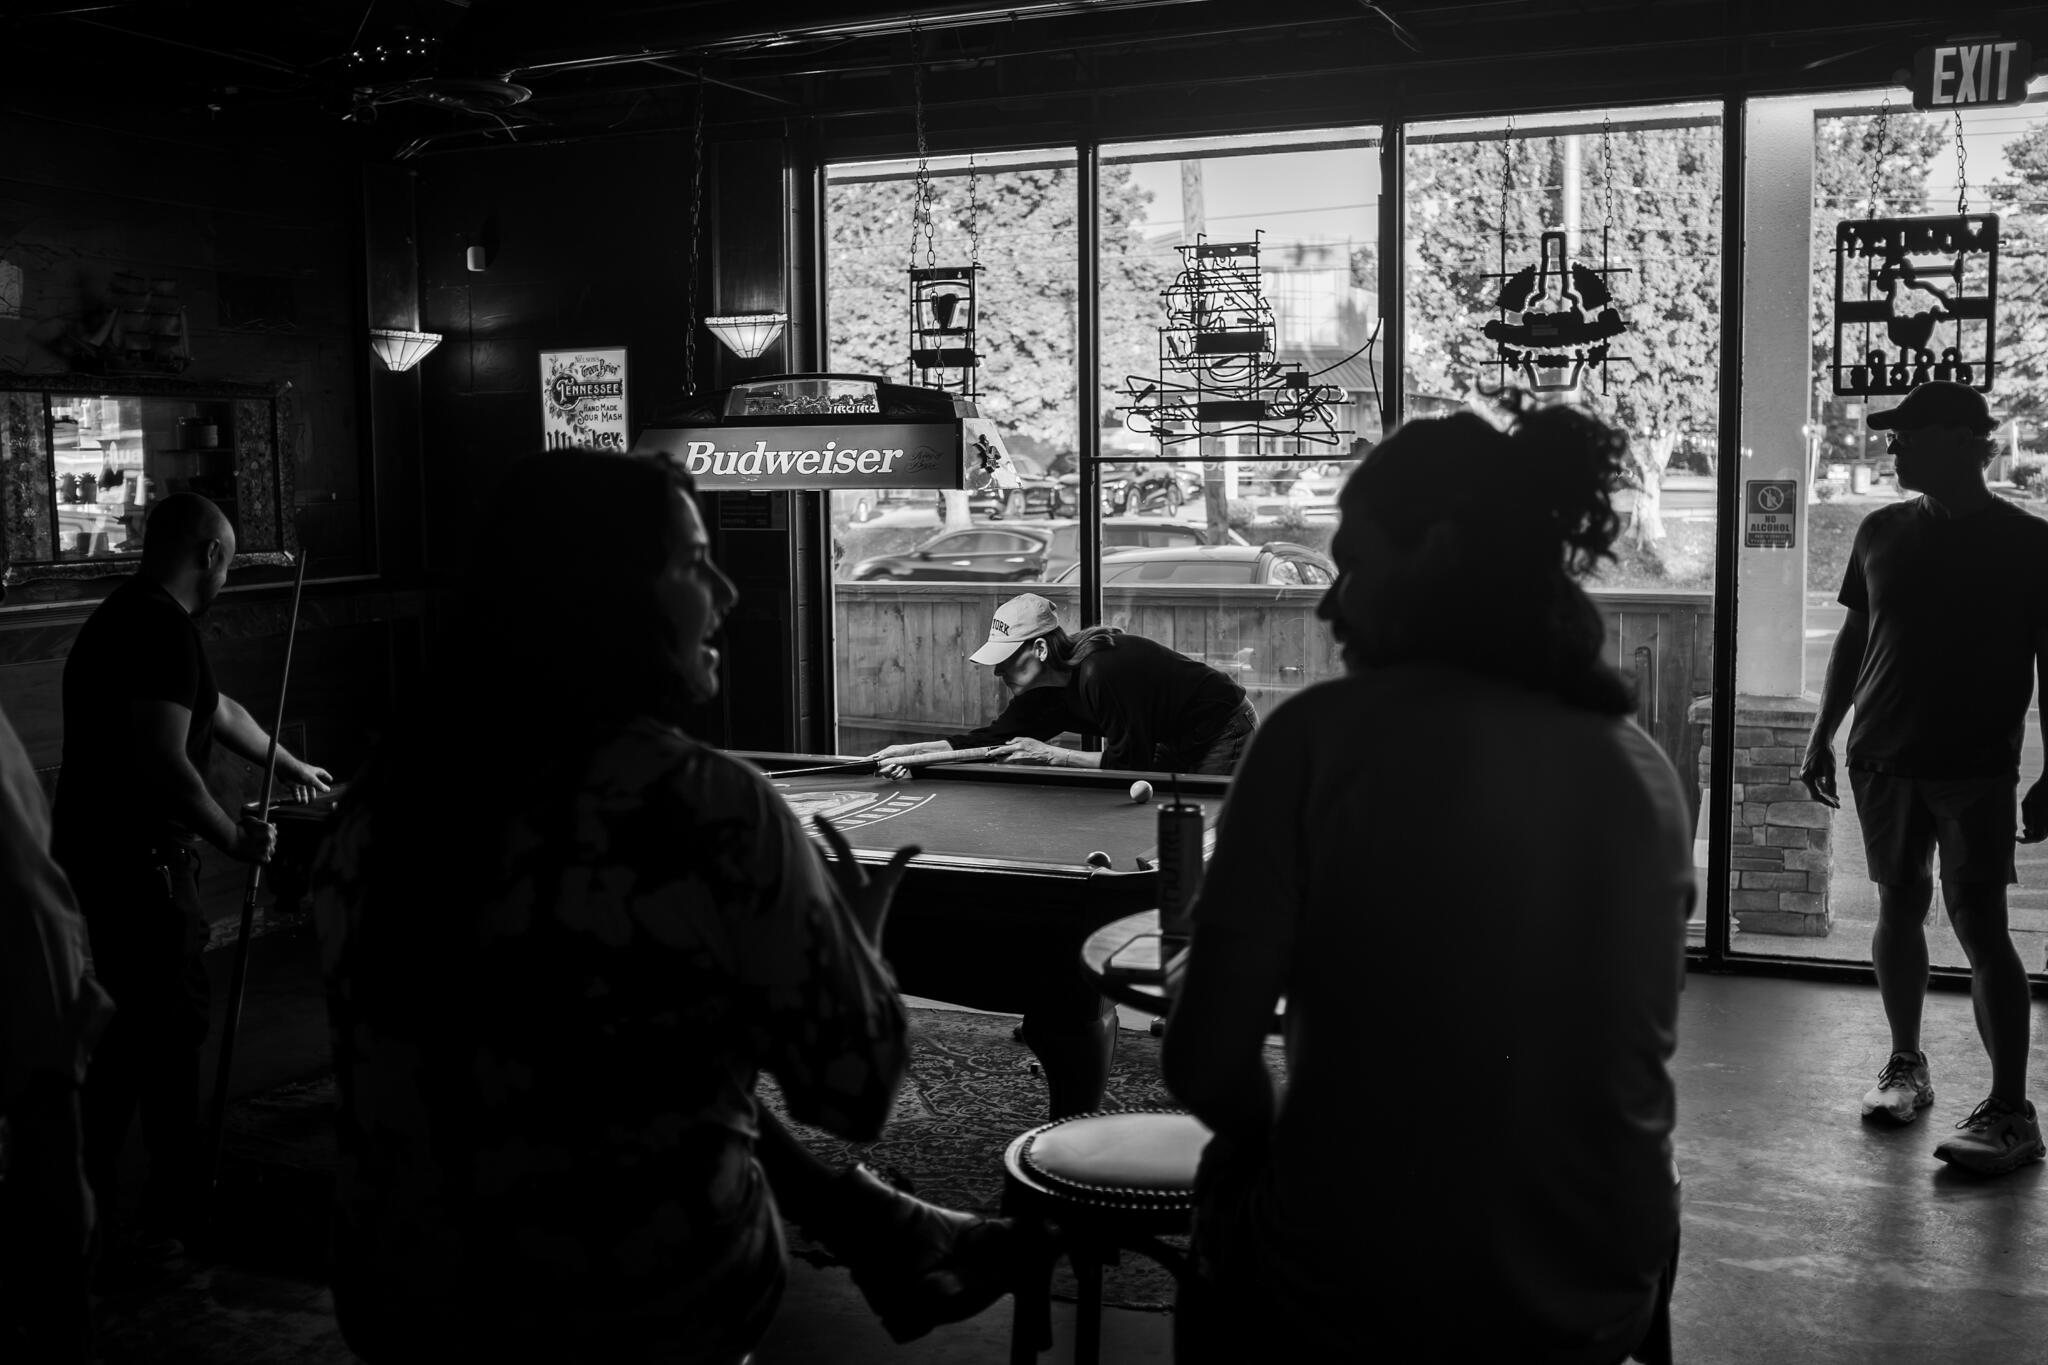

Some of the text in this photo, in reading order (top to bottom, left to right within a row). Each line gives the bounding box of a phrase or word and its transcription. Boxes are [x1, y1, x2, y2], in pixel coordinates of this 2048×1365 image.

[1932, 42, 2017, 104] EXIT
[556, 378, 619, 404] TENNESSEE
[583, 403, 618, 412] HAND MADE
[577, 411, 623, 425] SOUR MASH
[686, 441, 903, 476] Budweiser
[1764, 515, 1777, 523] NO
[1750, 523, 1790, 532] ALCOHOL
